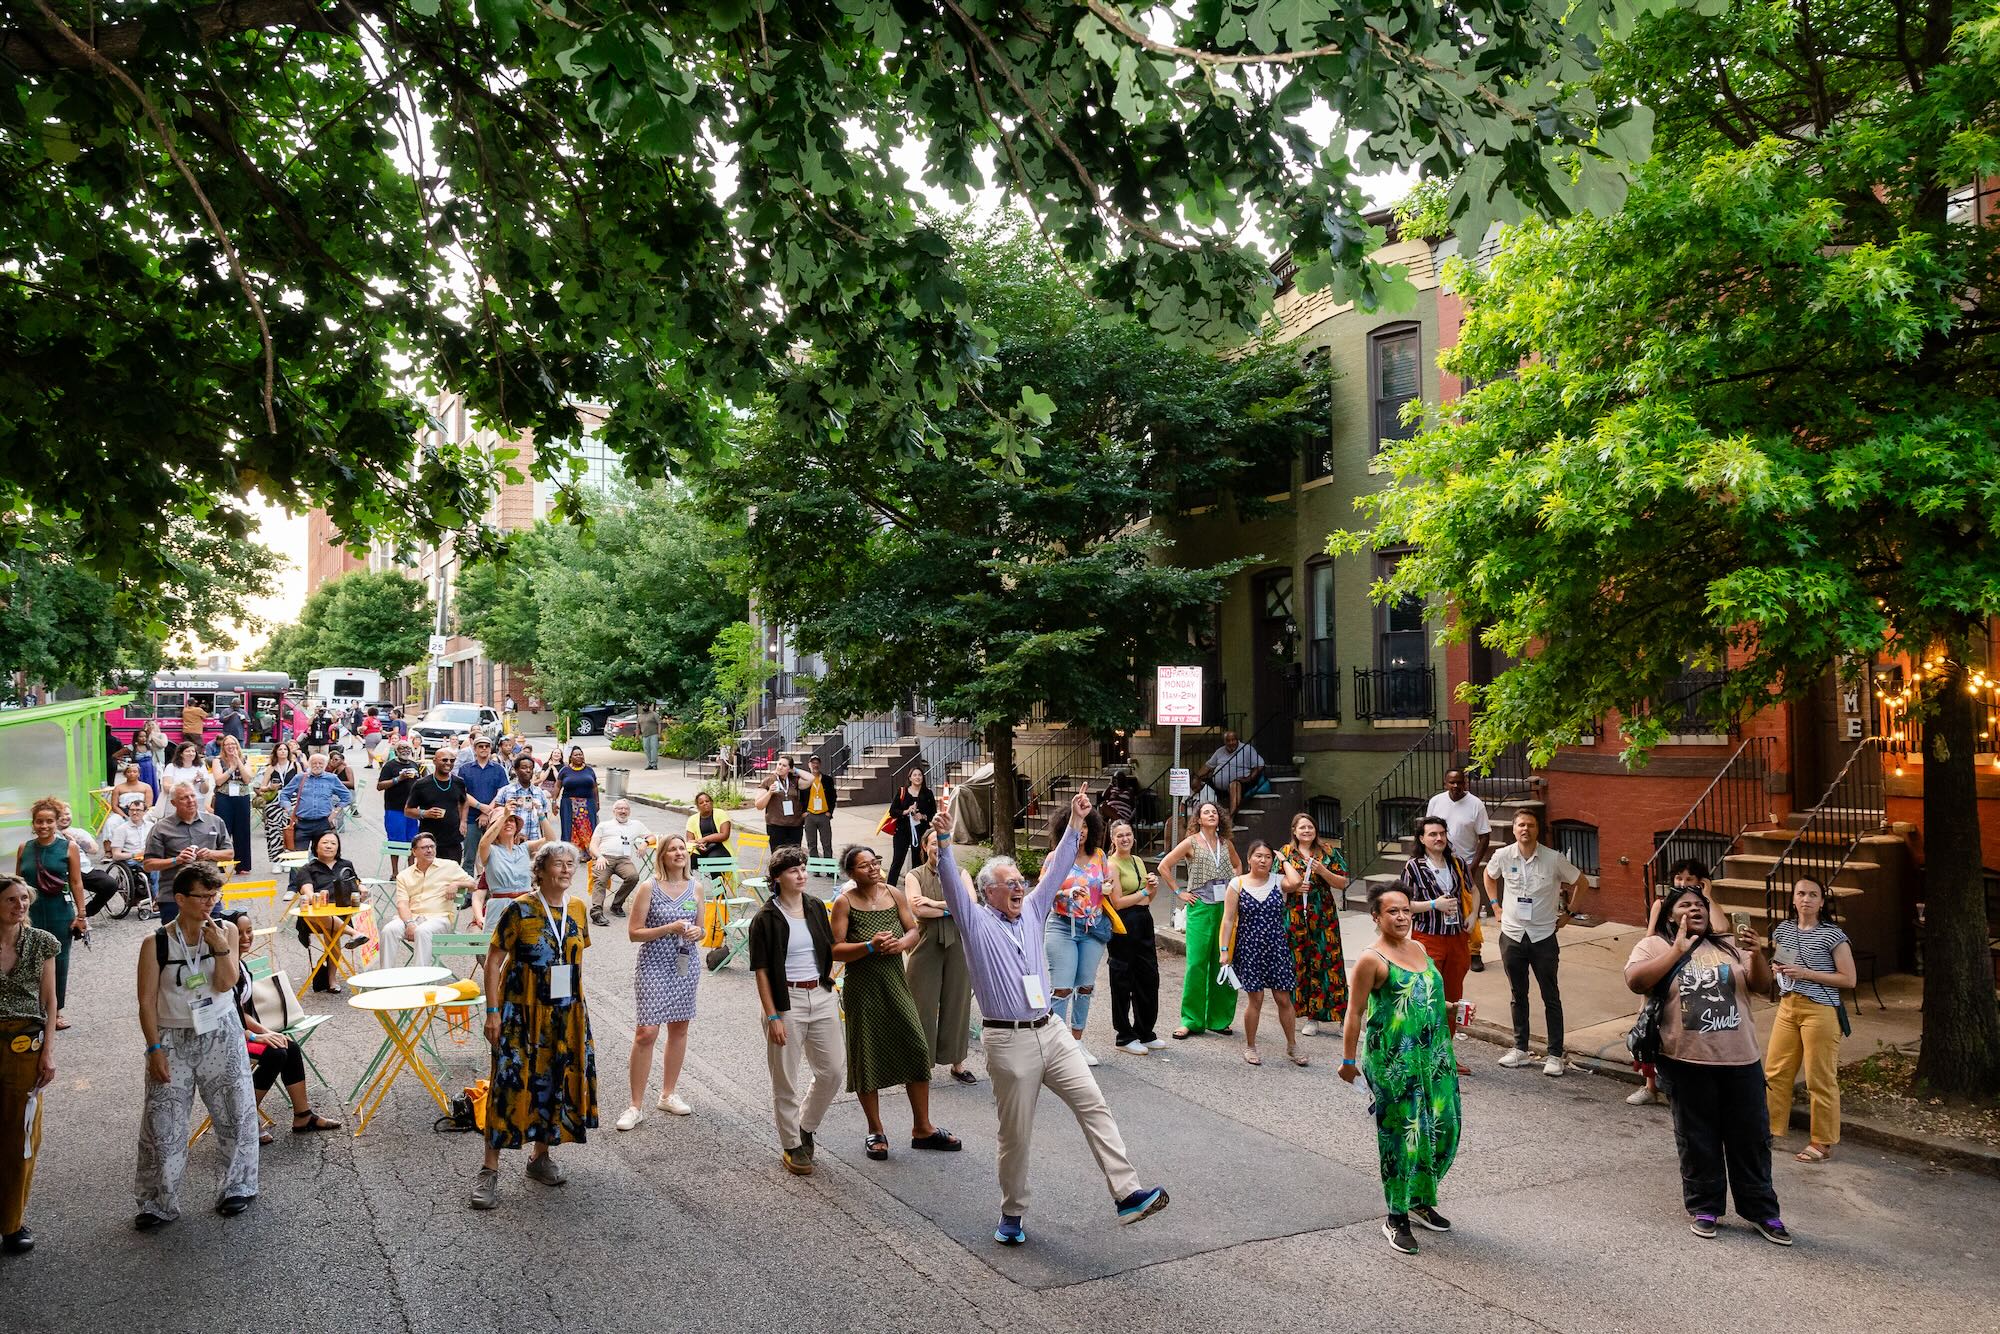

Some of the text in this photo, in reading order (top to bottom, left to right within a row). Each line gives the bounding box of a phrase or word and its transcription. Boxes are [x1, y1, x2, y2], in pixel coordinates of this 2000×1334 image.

[432, 641, 443, 650] 25
[1160, 668, 1170, 677] NO
[176, 680, 219, 689] QUEENS
[1164, 680, 1195, 688] MONDAY
